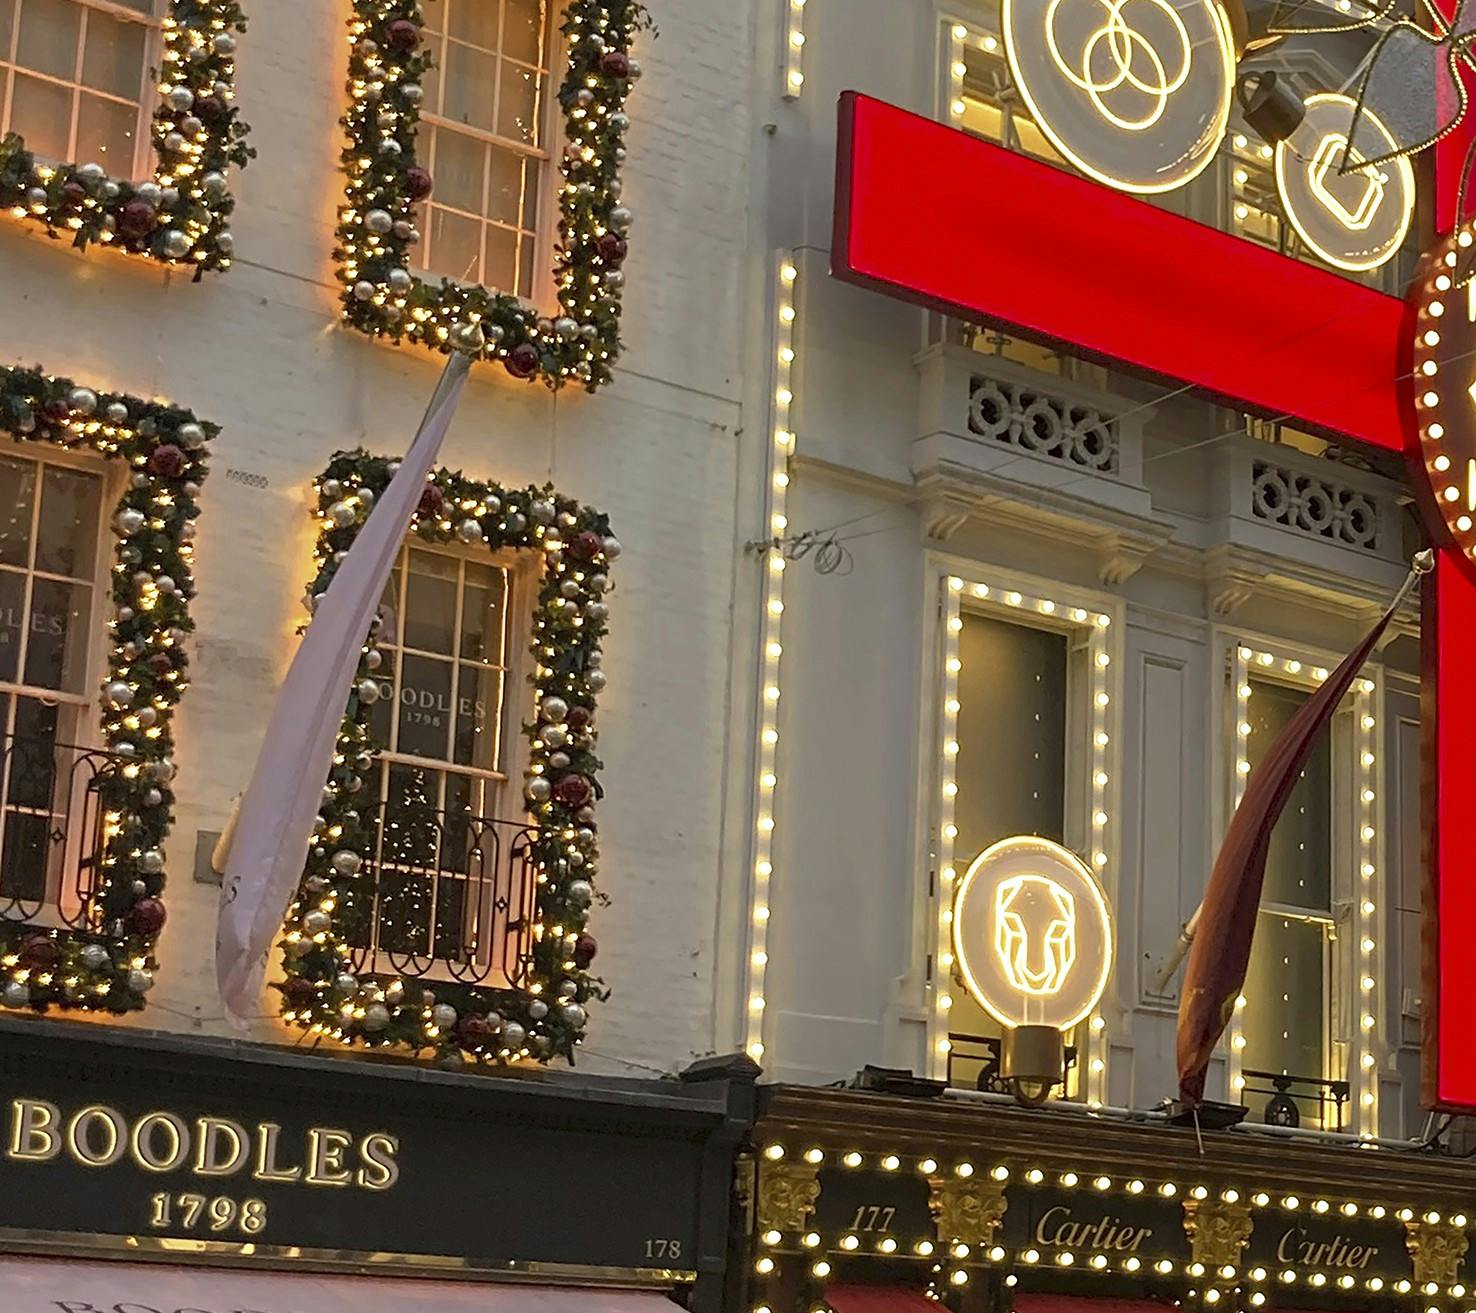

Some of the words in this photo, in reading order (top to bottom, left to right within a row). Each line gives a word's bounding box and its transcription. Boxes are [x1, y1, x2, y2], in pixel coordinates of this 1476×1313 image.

[8, 1099, 400, 1189] BOODLES
[150, 1191, 267, 1234] 1798
[850, 1205, 896, 1234] 177
[1036, 1206, 1153, 1252] Cartier
[645, 1239, 681, 1259] 178
[1277, 1227, 1378, 1270] Cartier
